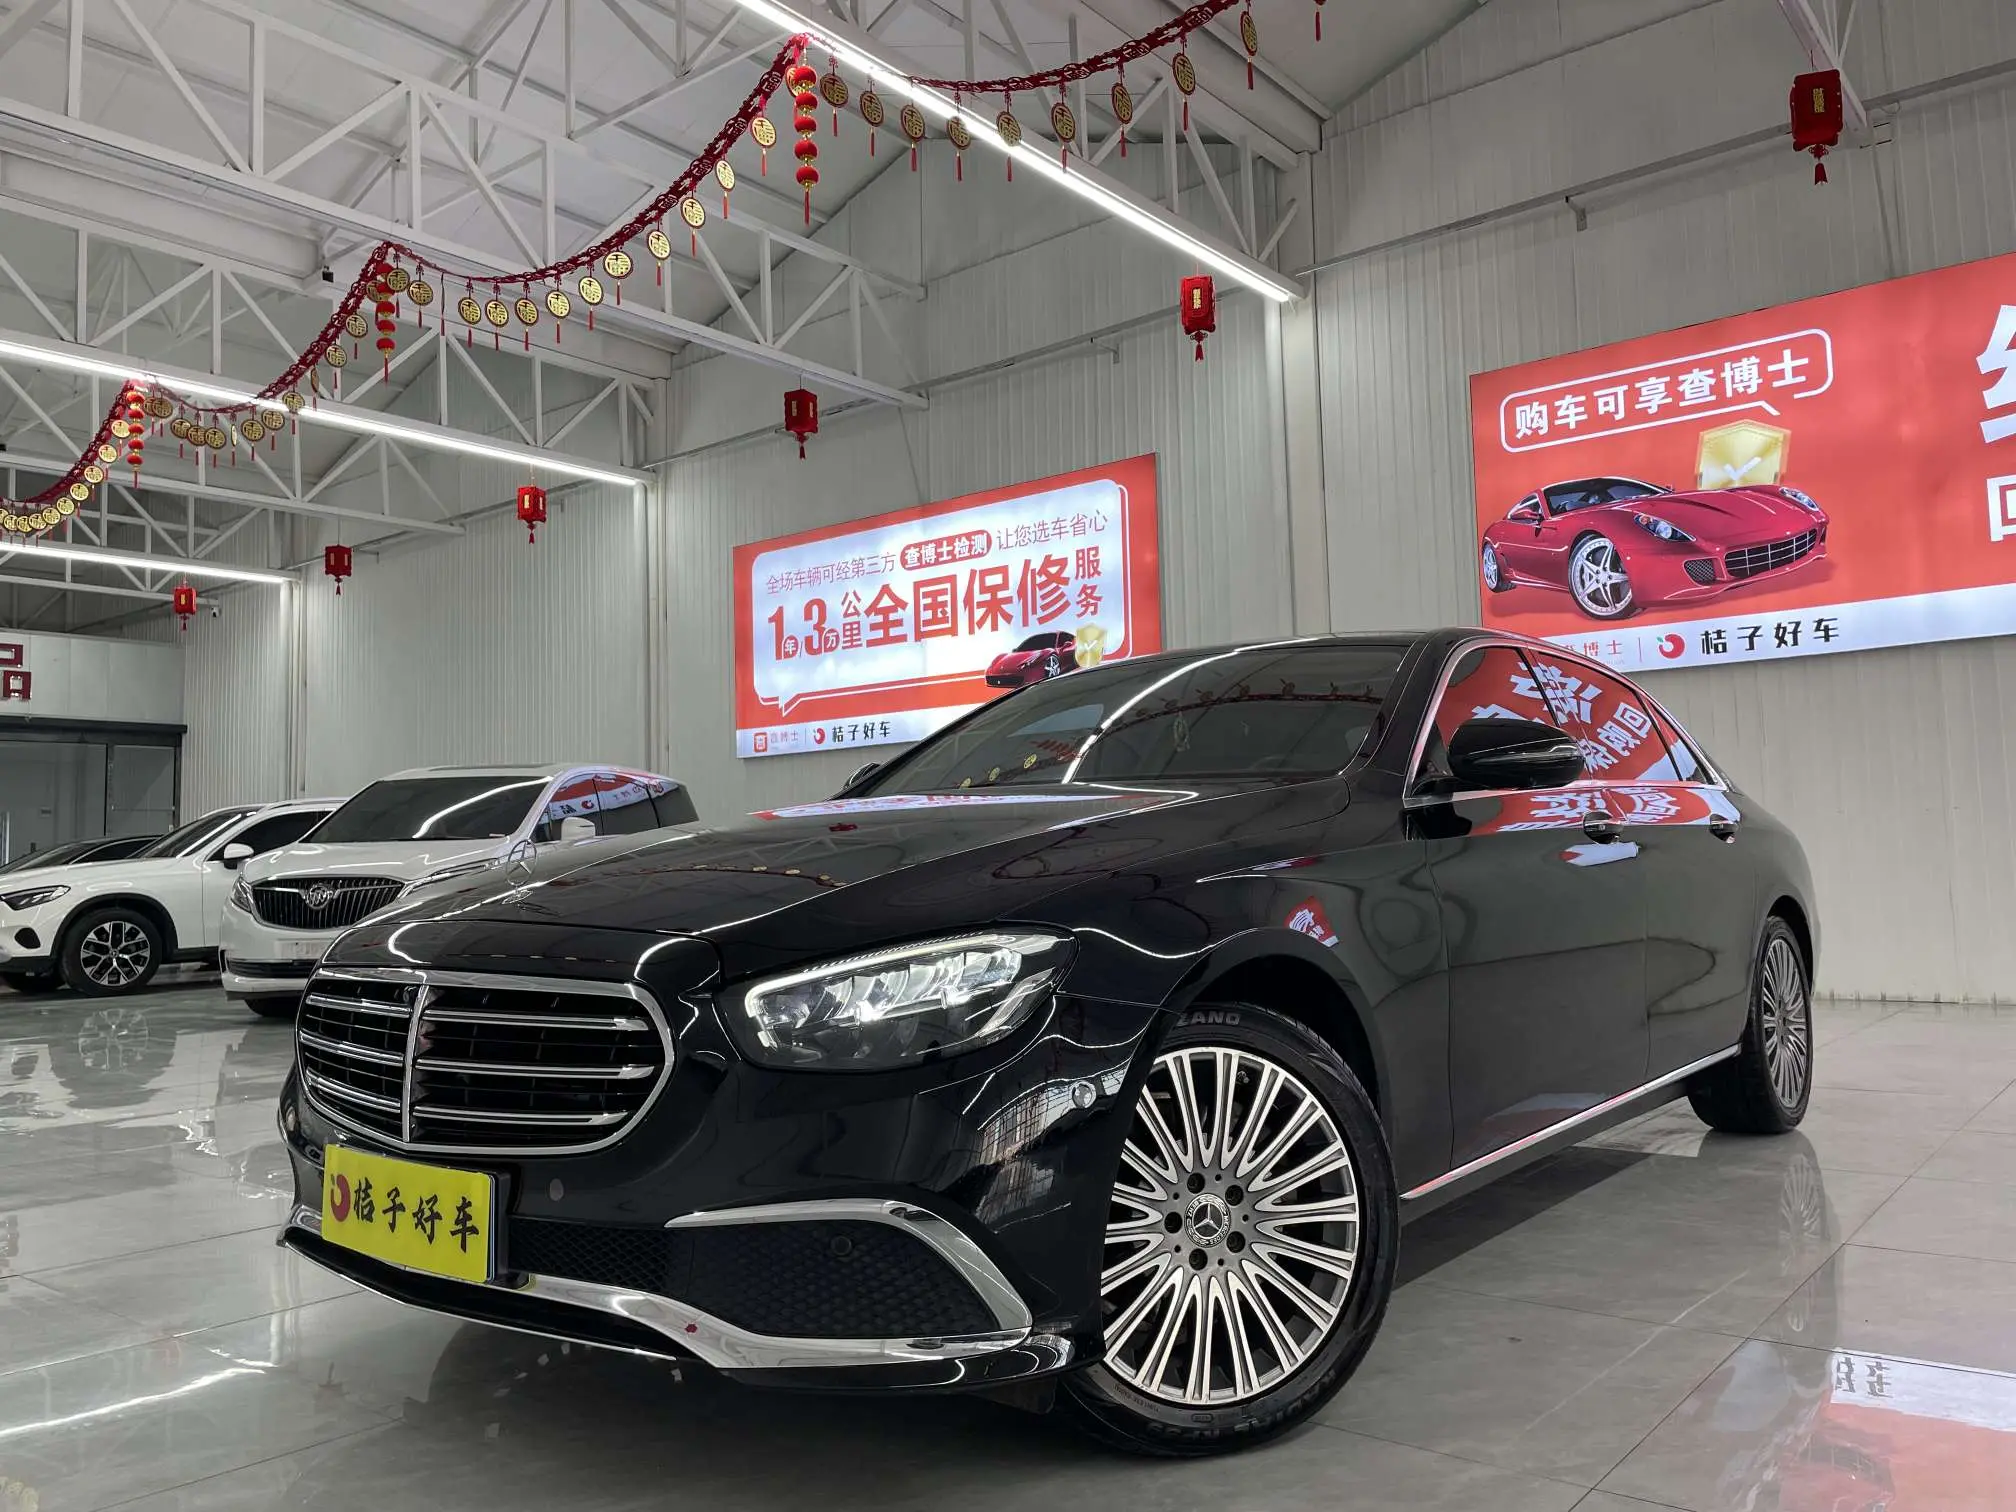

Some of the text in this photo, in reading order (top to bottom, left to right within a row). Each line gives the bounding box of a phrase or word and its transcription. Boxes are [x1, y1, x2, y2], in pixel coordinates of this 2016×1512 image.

[1515, 348, 1811, 440] 购车可享查博士
[766, 509, 1108, 595] 全场车辆可经第三方 查博士检测 让您选车省心
[1700, 617, 1839, 655] 桔子好车
[832, 721, 891, 743] 桔子好车
[354, 1177, 480, 1253] 桔子好车
